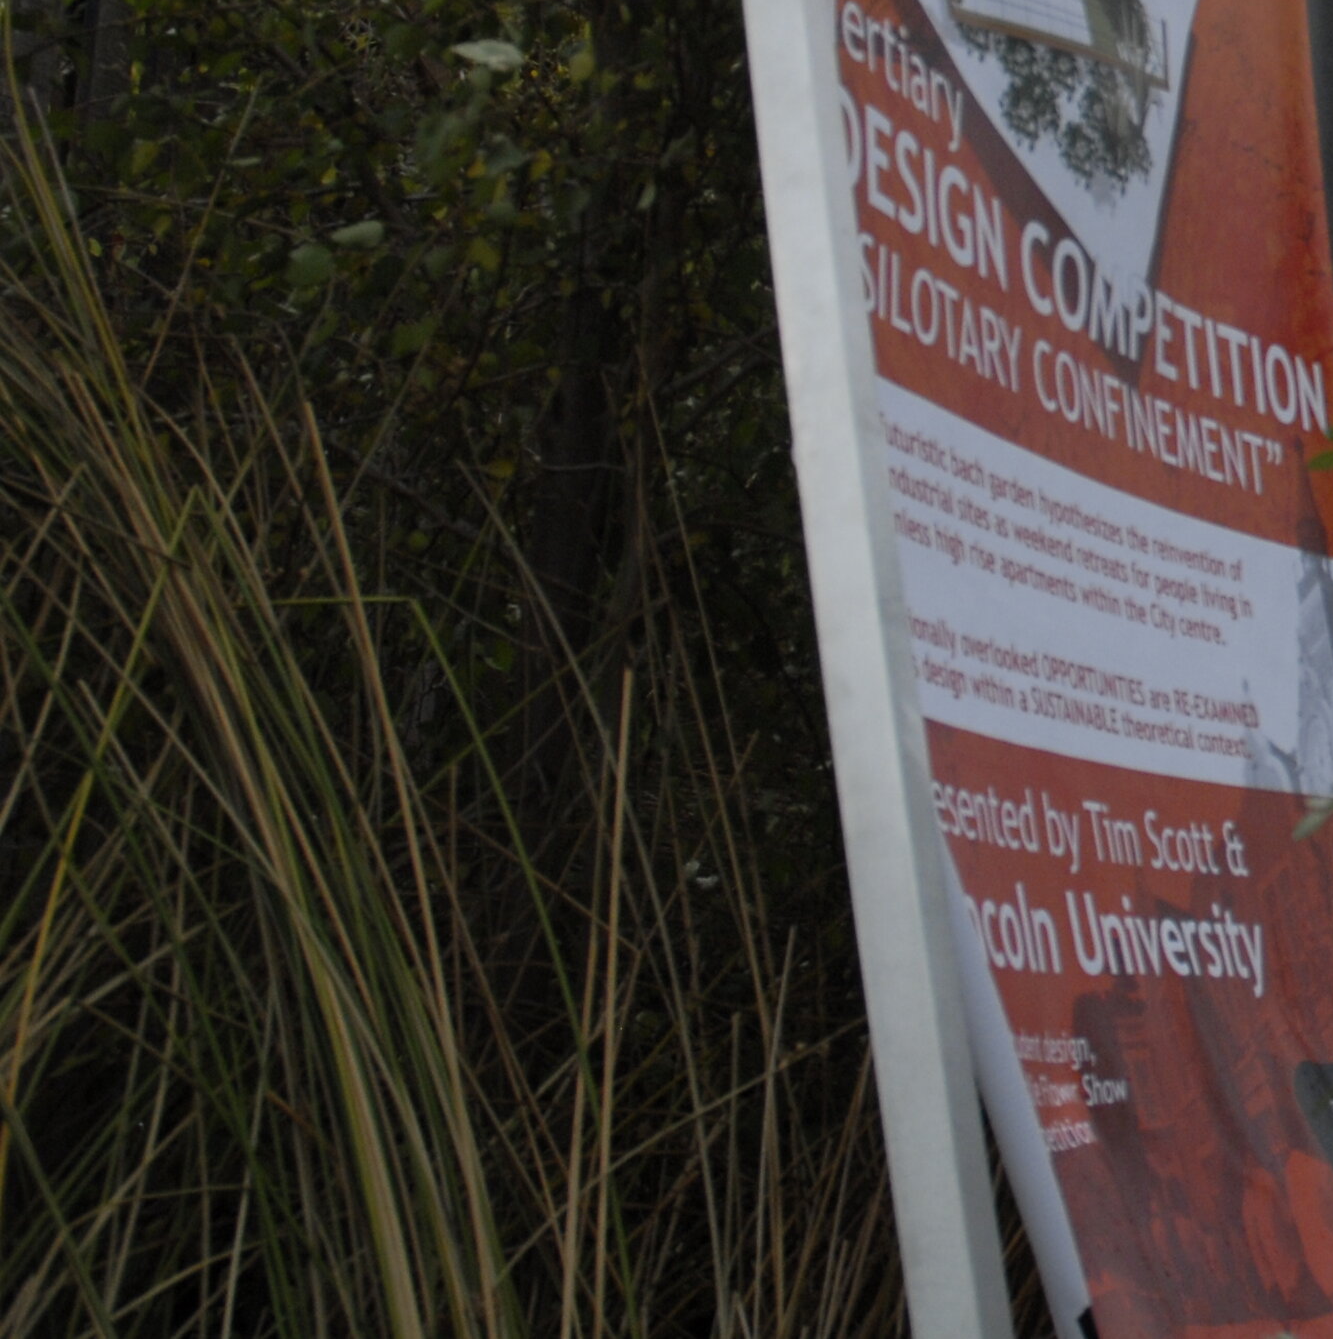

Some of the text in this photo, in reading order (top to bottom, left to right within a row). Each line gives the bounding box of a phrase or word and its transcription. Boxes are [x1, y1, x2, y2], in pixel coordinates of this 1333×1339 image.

[1020, 220, 1330, 435] COMPETITION
[881, 417, 948, 473] uturistic
[950, 445, 985, 487] bach
[988, 470, 1035, 509] garden
[1126, 525, 1149, 554] the
[1152, 537, 1226, 577] reinvention
[1230, 558, 1242, 581] of
[888, 466, 954, 514] ndustrial
[957, 495, 990, 531] sites
[1012, 522, 1073, 564] weekend
[1076, 546, 1129, 583] retreats
[1131, 562, 1149, 588] for
[1155, 575, 1198, 605] people
[1201, 582, 1238, 621] living
[1239, 593, 1253, 618] in
[934, 521, 965, 565] high
[969, 540, 994, 574] rise
[1001, 556, 1077, 604] apartments
[1080, 585, 1122, 617] within
[1124, 597, 1147, 624] the
[1150, 602, 1175, 638] City
[923, 652, 968, 699] design
[971, 672, 1014, 709] within
[1019, 690, 1028, 712] a
[1031, 685, 1120, 735] SUSTAINABLE
[1121, 711, 1194, 749] theoretical
[961, 634, 1039, 679] overlooked
[1042, 653, 1145, 706] OPPORTUNITIES
[1149, 689, 1170, 712] are
[1042, 791, 1080, 874] by
[1083, 800, 1144, 867] Tim
[1144, 809, 1220, 875] Scott
[1222, 819, 1249, 877] &
[964, 880, 1263, 998] ncoln University
[1082, 1074, 1128, 1107] Show
